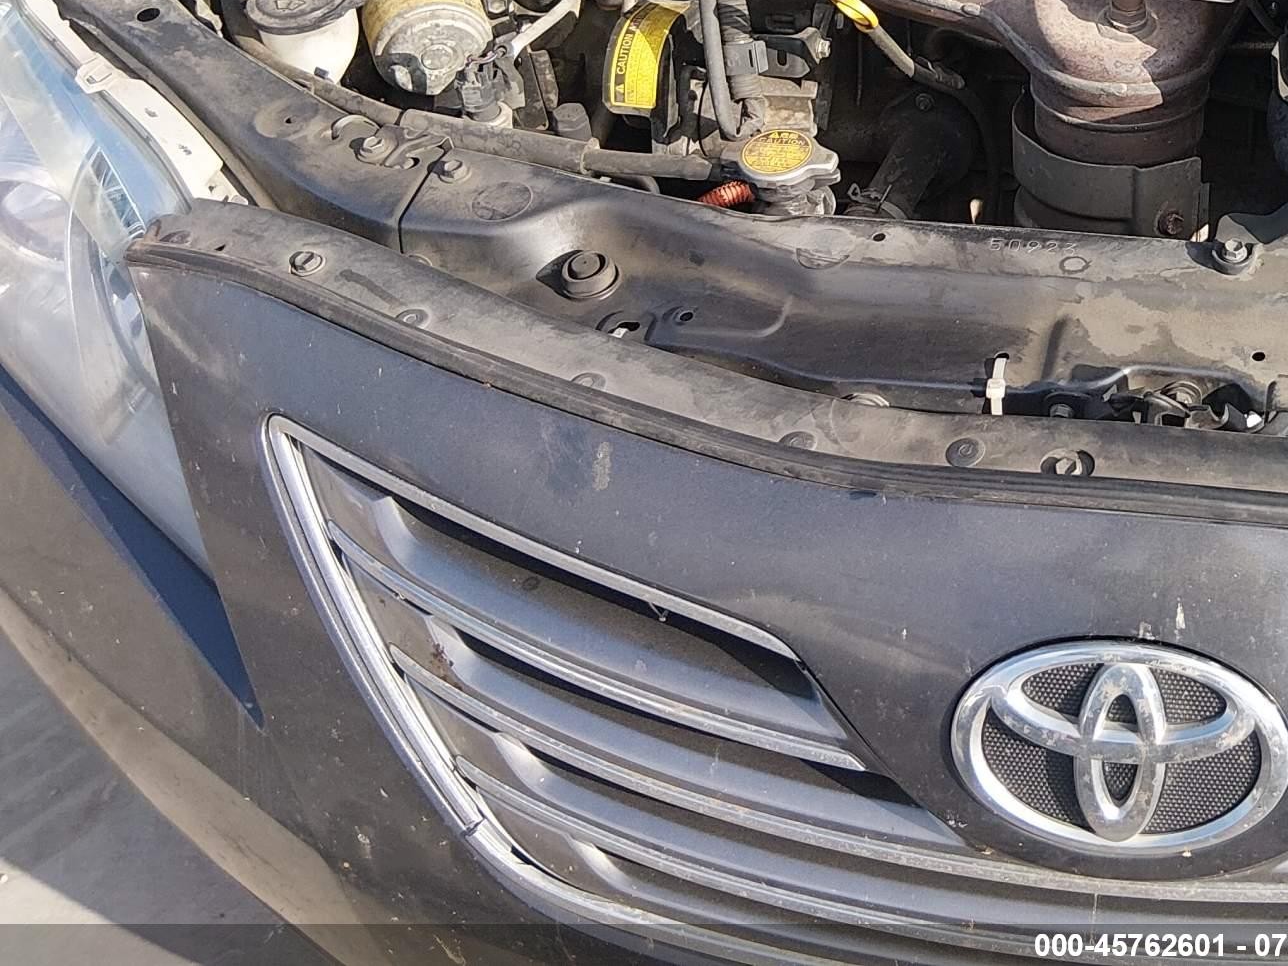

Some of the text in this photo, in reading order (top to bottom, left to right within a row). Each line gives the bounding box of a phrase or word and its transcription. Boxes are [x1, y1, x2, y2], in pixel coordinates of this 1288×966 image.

[616, 33, 634, 75] CAUTION
[760, 137, 806, 146] CAUTION
[990, 237, 1077, 256] 50923
